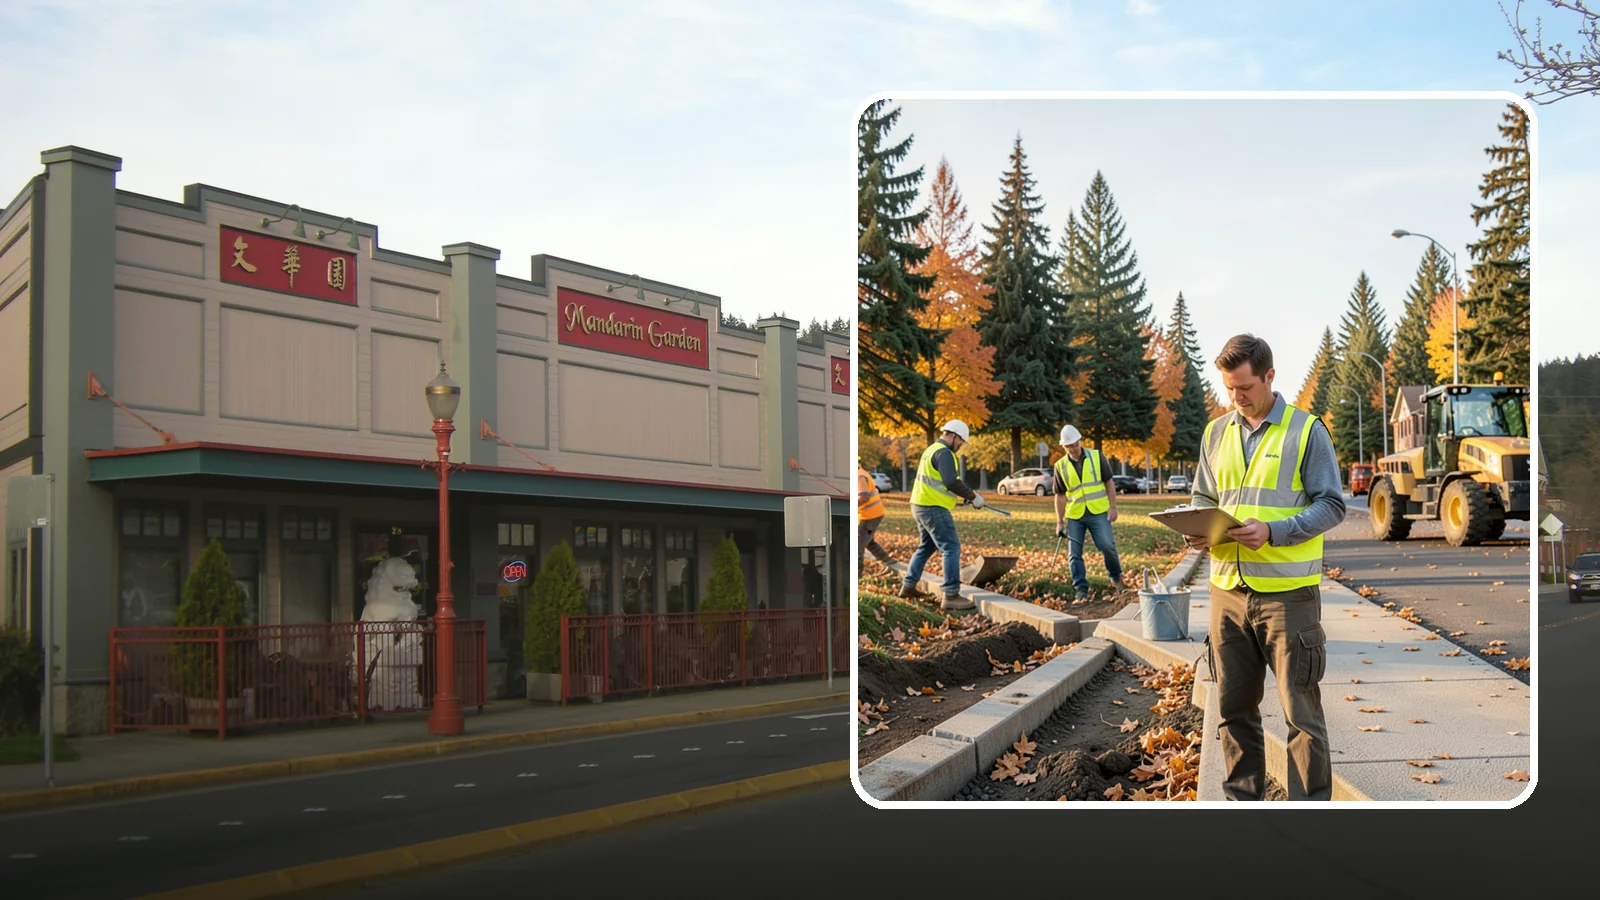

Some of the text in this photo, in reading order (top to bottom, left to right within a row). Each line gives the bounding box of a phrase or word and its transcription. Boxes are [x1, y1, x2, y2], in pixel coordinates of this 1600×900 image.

[230, 235, 346, 291] 文華園
[564, 302, 701, 352] Mandarin Garden
[503, 565, 527, 578] OPEN
